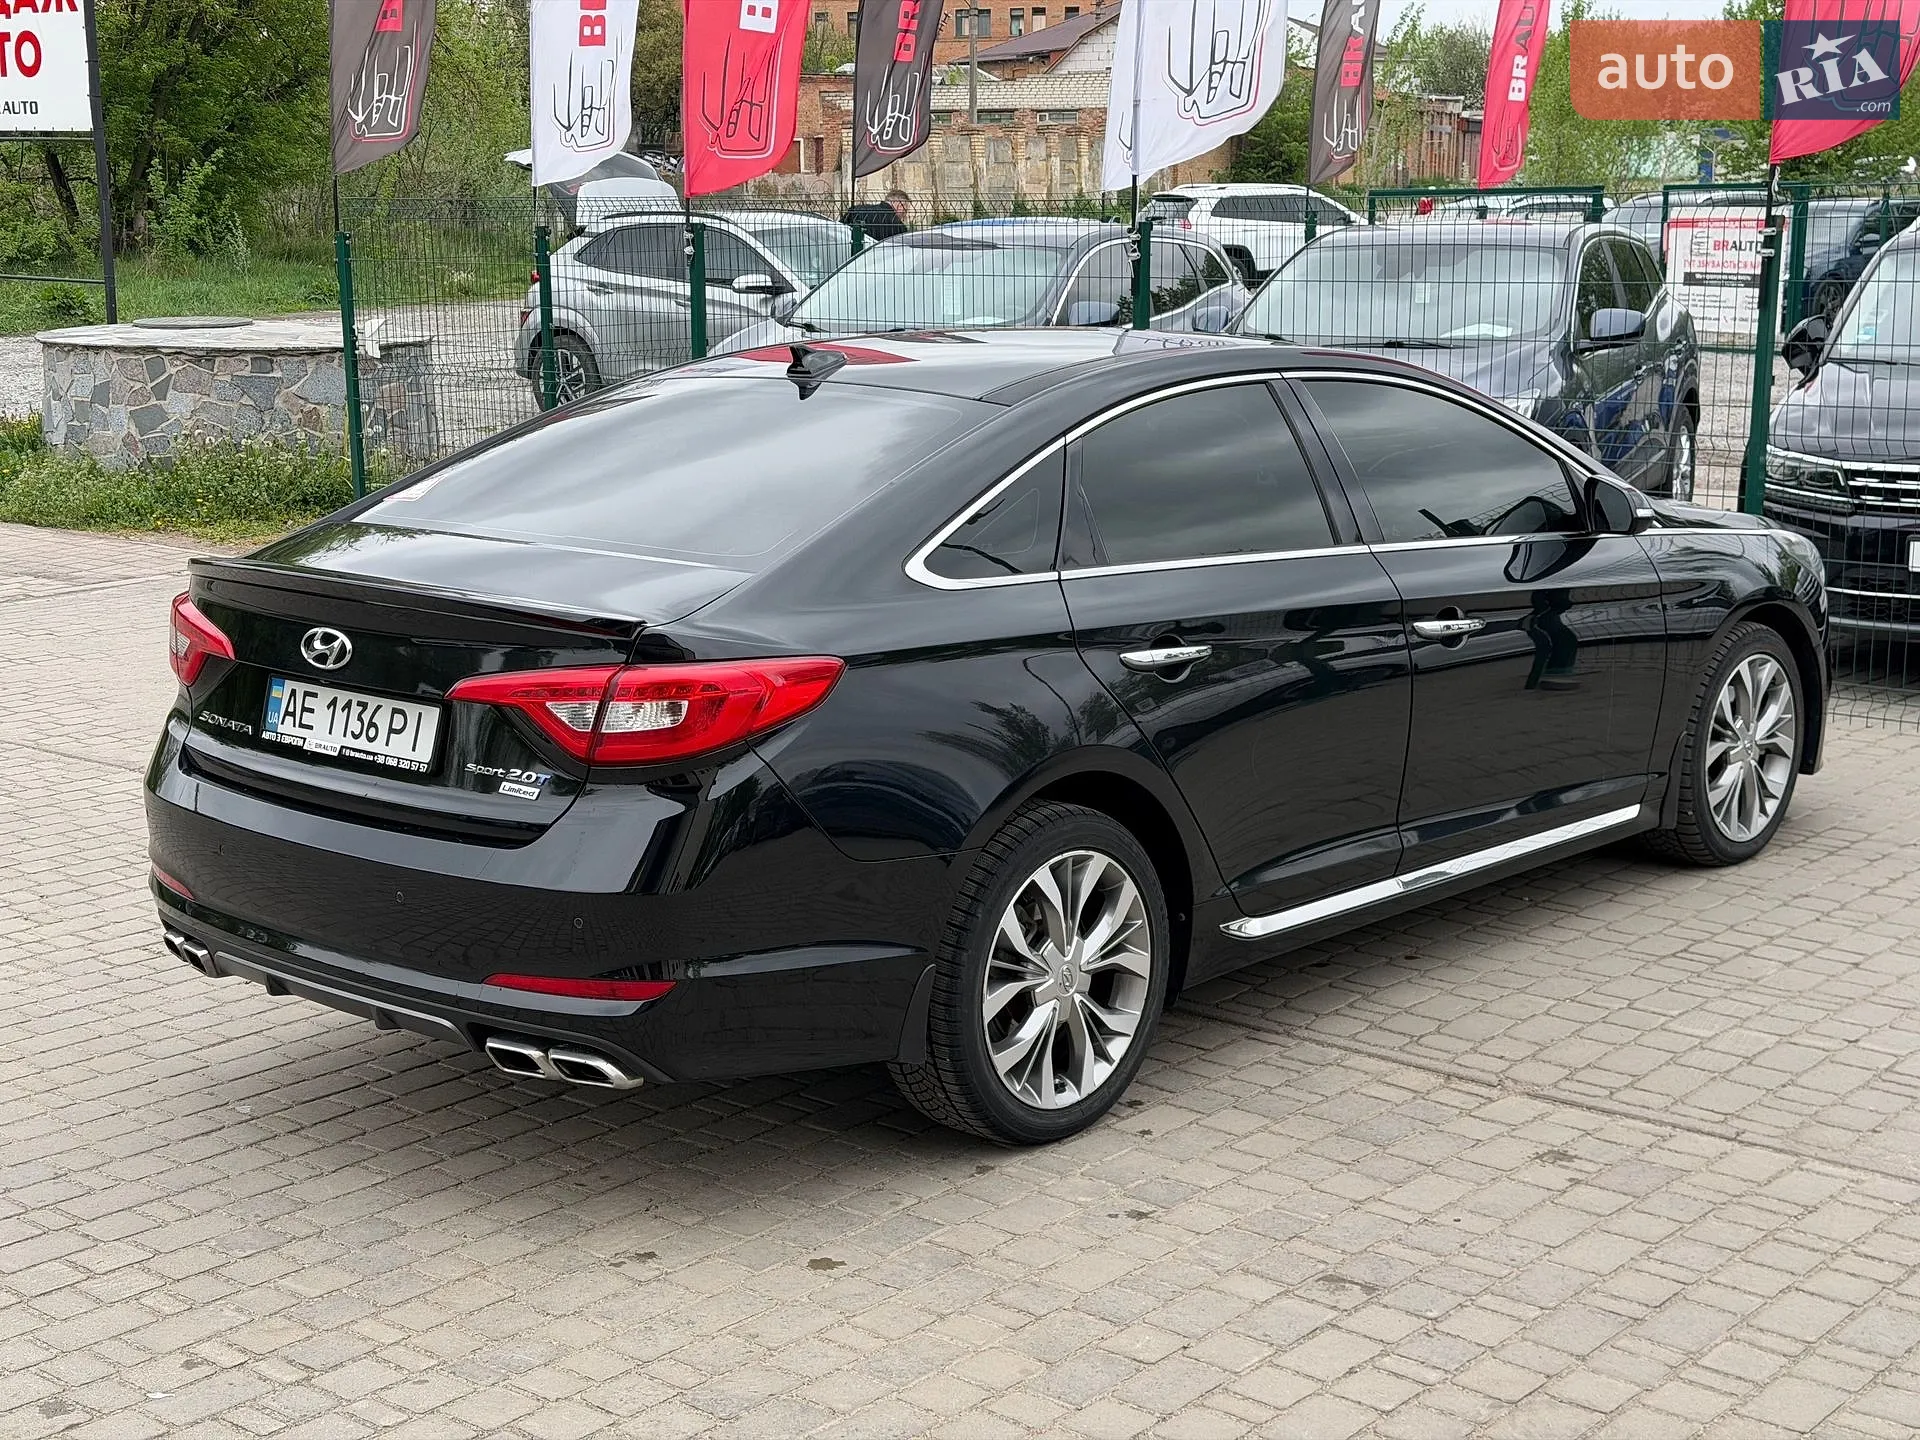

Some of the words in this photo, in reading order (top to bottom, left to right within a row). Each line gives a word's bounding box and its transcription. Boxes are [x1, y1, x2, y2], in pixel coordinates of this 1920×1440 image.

[0, 101, 38, 115] AUTO
[268, 711, 278, 724] UA
[281, 688, 319, 731] AE
[326, 696, 383, 743] 1136
[199, 710, 252, 736] SONATA
[410, 762, 419, 771] 57
[419, 763, 428, 772] 57
[464, 763, 506, 778] Sport
[502, 784, 536, 797] Limited
